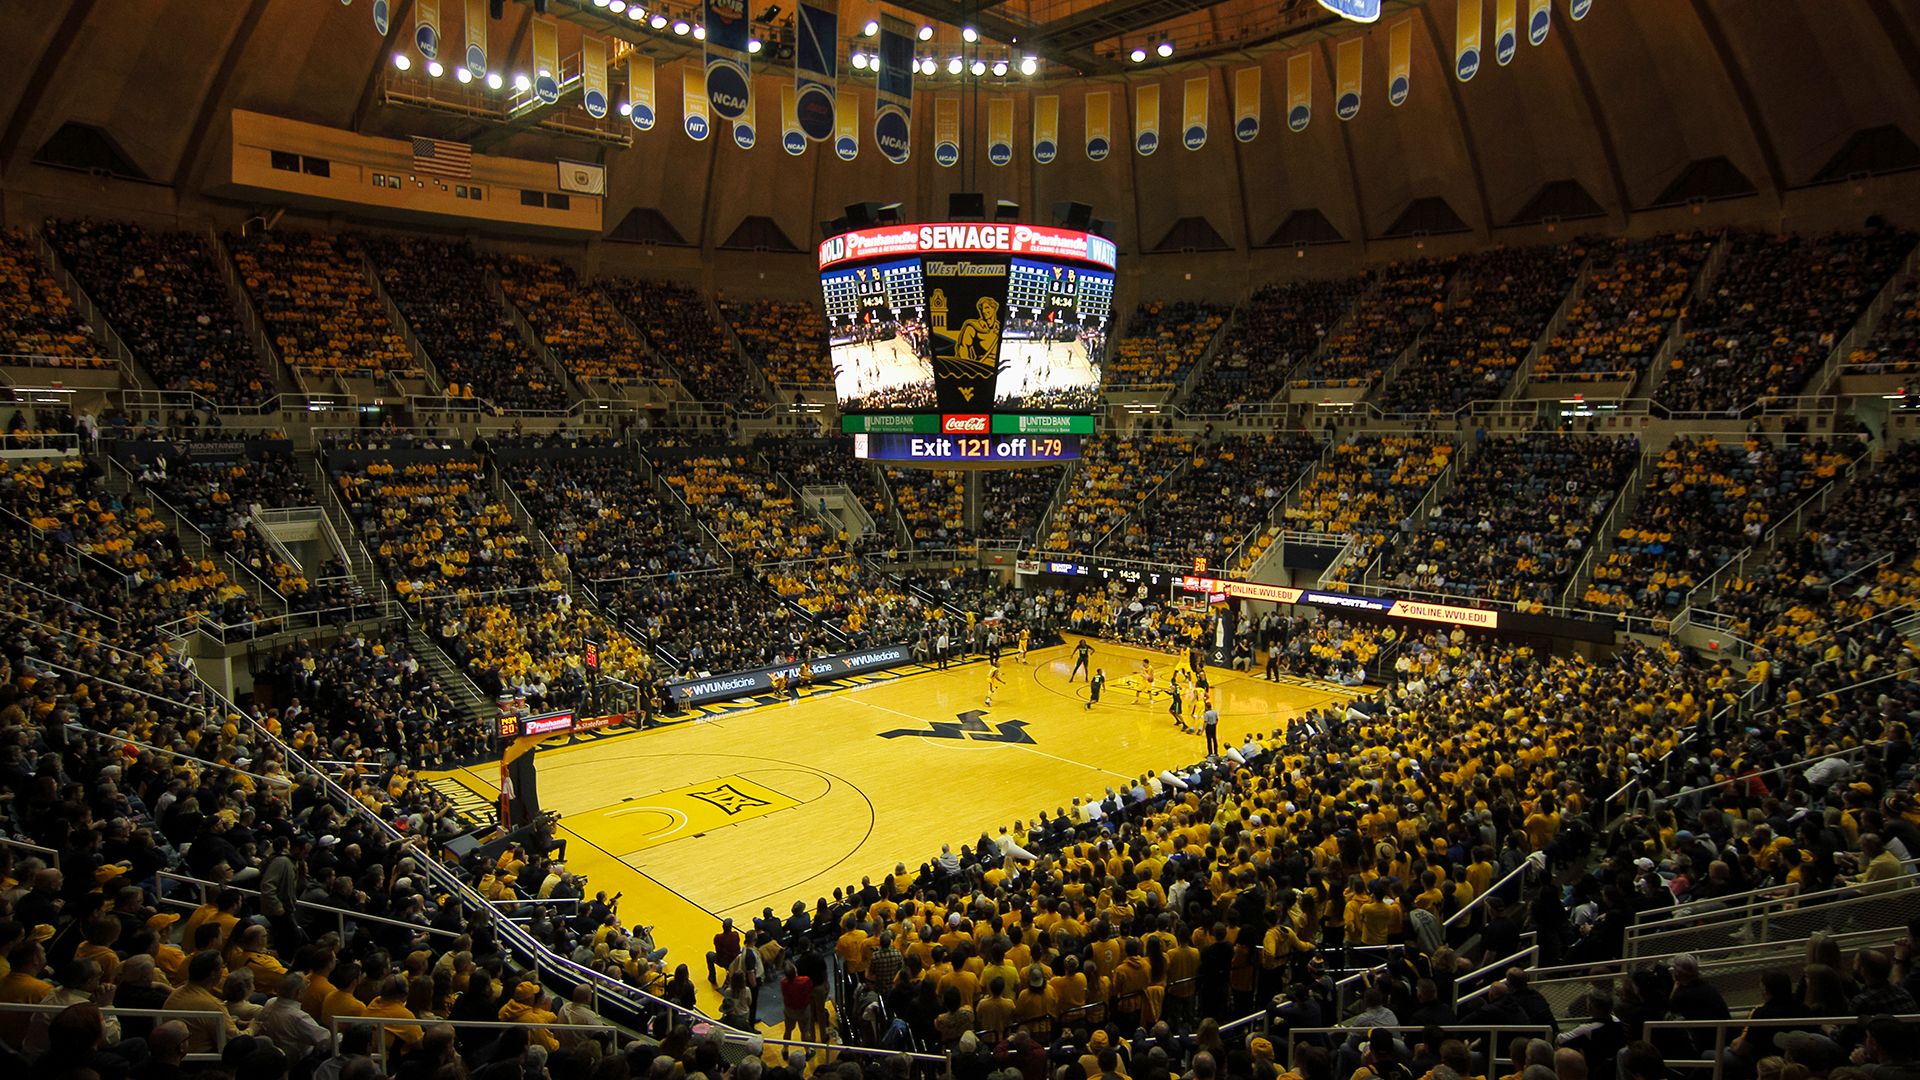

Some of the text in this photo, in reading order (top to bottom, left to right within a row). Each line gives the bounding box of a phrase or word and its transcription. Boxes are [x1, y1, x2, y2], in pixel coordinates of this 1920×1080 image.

[1500, 46, 1514, 59] NCAA
[470, 62, 485, 73] NCAA
[1460, 64, 1477, 76] NCAA
[539, 88, 557, 99] NCAA
[1392, 89, 1407, 100] NCAA
[713, 91, 748, 110] NCAA
[589, 103, 606, 113] NCAA
[1340, 105, 1358, 115] NCAA
[635, 116, 653, 126] NCAA
[1291, 118, 1308, 127] NCAA
[689, 122, 705, 132] NIT
[1239, 129, 1257, 137] NCAA
[738, 136, 754, 144] NCAA
[881, 135, 909, 152] NCAA
[1187, 137, 1204, 145] NCAA
[858, 231, 918, 248] Panhandle
[920, 226, 1010, 250] SEWAGE
[1031, 232, 1088, 251] Panhandle
[927, 262, 1005, 275] WEST VIRGINIA
[861, 282, 881, 293] 8 8
[1053, 282, 1073, 293] 8 8
[863, 296, 883, 307] 14:34
[1051, 296, 1072, 307] 14:34
[871, 416, 914, 425] UNITED BANK
[945, 418, 986, 430] Coca-Cola
[1027, 417, 1071, 426] UNITED BANK
[911, 438, 1062, 457] Exit 121 off I-79
[1194, 563, 1206, 572] 20
[1119, 570, 1140, 580] 14:34
[1232, 585, 1293, 599] ONLINE.WVU.EDU
[1410, 606, 1487, 623] ONLINE.WVU.EDU
[536, 718, 572, 729] Panhandle
[502, 724, 515, 735] 20
[1105, 950, 1113, 963] 3
